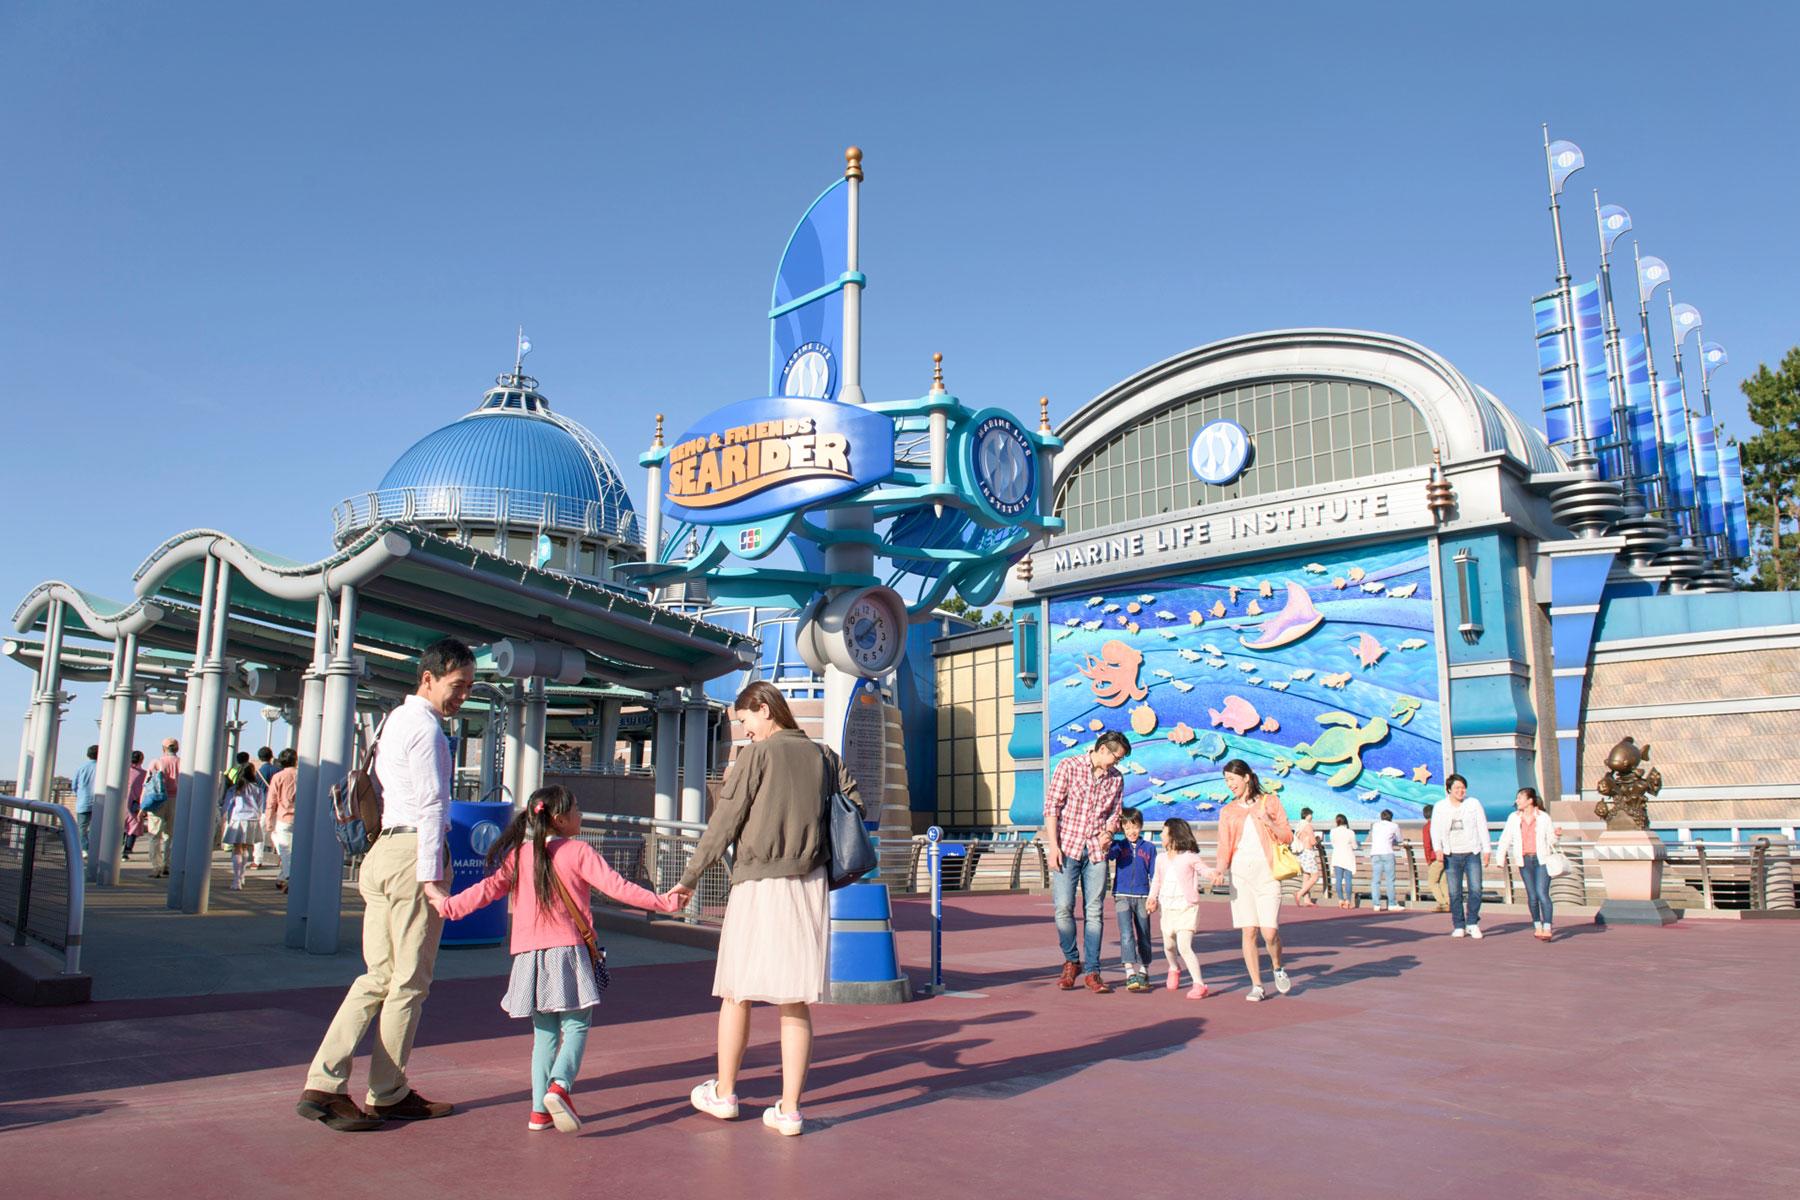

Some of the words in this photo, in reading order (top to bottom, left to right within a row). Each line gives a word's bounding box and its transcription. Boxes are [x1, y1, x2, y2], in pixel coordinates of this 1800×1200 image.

[815, 343, 831, 360] LIFE
[669, 437, 706, 464] NEMO
[708, 433, 722, 449] &
[724, 417, 815, 446] FRIENDS
[978, 419, 1011, 439] MARINE
[1014, 429, 1032, 457] LIFE
[669, 432, 850, 495] SEARIDER
[980, 480, 1030, 514] INSTITUTE
[1053, 533, 1145, 573] MARINE
[1155, 521, 1212, 551] LIFE
[1229, 493, 1390, 540] INSTITUTE
[881, 632, 886, 641] 3
[855, 649, 860, 658] 7
[871, 651, 877, 660] 5
[878, 645, 883, 653] 4
[863, 653, 868, 662] 6
[453, 858, 488, 867] MARIN
